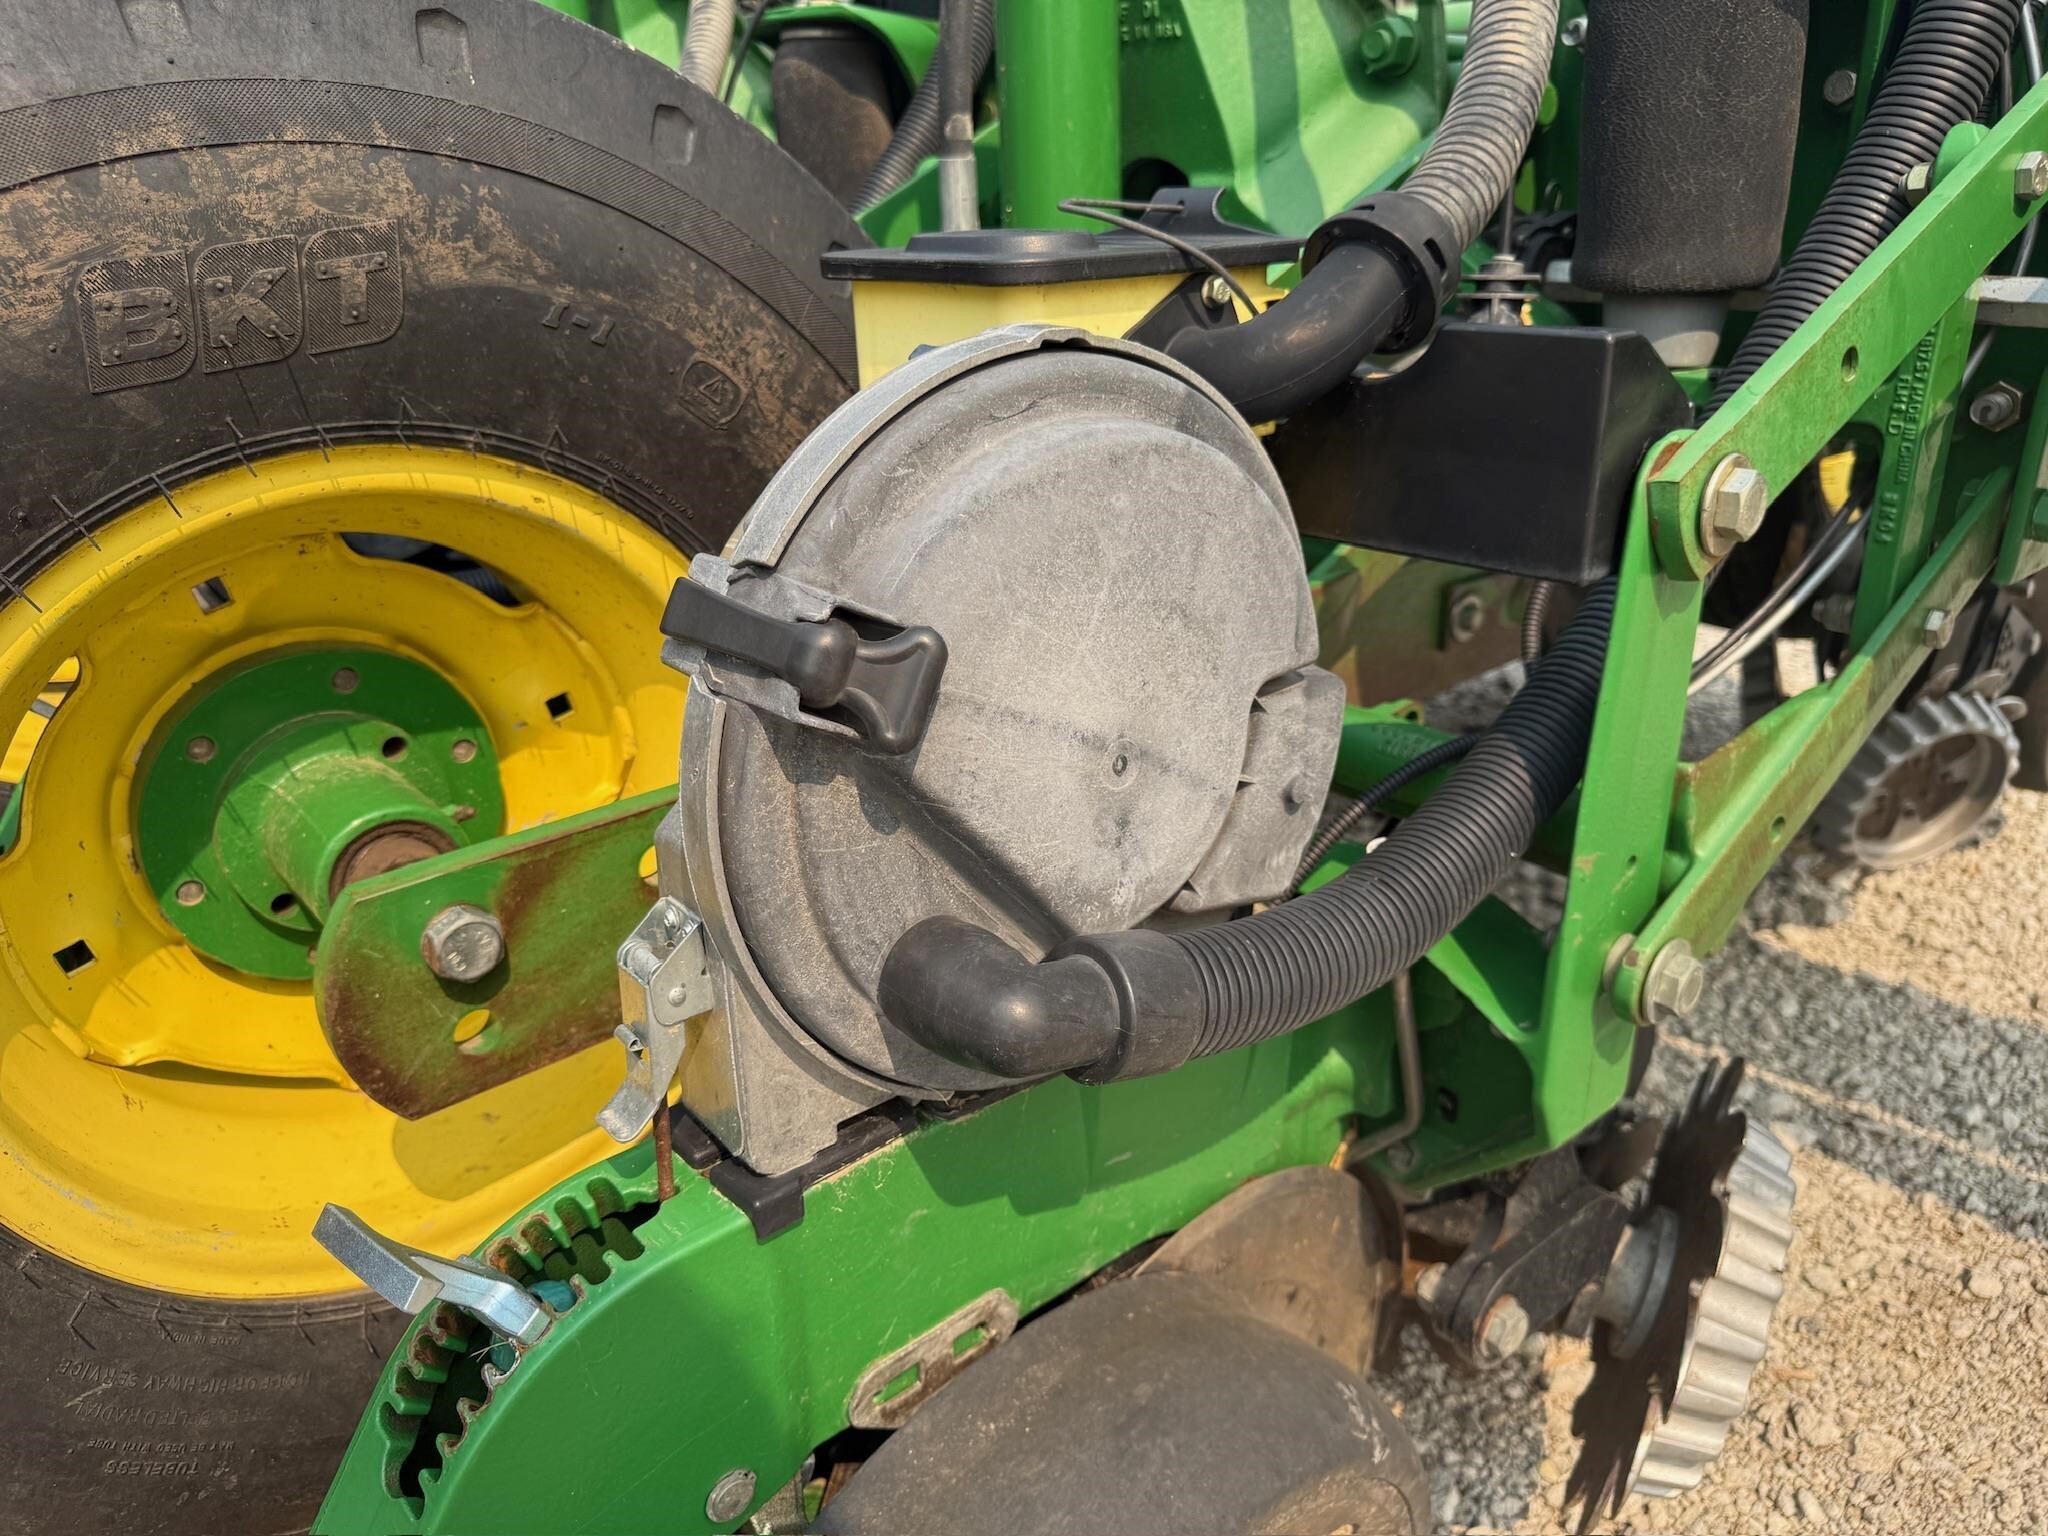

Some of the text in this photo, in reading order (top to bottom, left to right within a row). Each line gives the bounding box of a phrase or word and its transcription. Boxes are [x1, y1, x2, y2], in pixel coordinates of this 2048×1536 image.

[92, 247, 392, 369] BKT
[56, 1358, 140, 1390] SERVICE
[144, 1375, 230, 1394] HIGHWAY
[74, 1400, 142, 1425] RADIAL
[87, 1438, 119, 1450] TUBE
[122, 1441, 152, 1455] WITH
[158, 1442, 186, 1454] USED
[210, 1440, 235, 1452] MAY
[104, 1459, 200, 1477] TUBELESS
